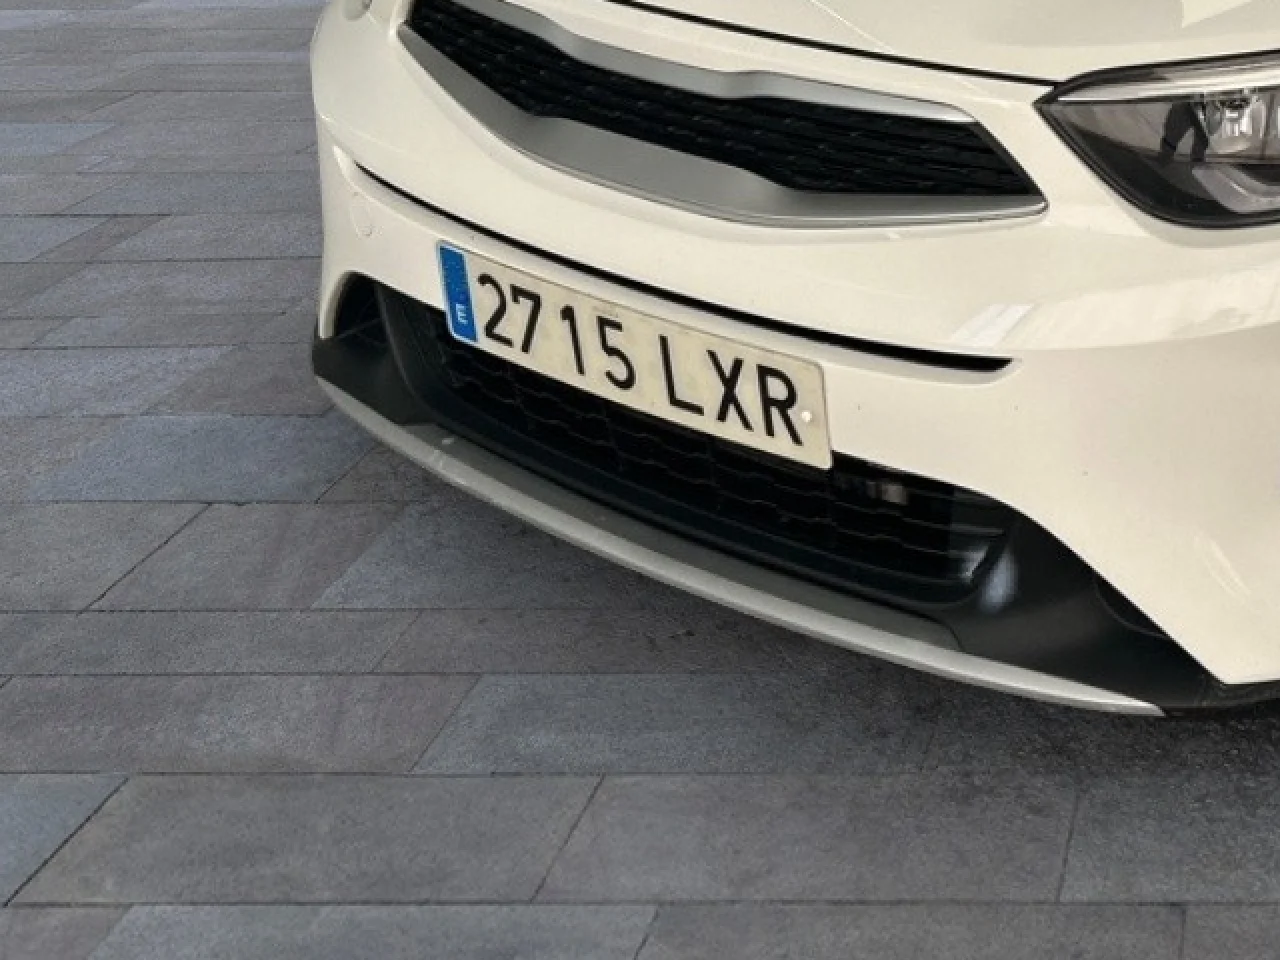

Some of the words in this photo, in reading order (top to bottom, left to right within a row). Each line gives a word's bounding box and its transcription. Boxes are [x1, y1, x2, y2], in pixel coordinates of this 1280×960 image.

[455, 303, 468, 324] E
[477, 272, 637, 391] 2715
[659, 334, 803, 447] LXR
